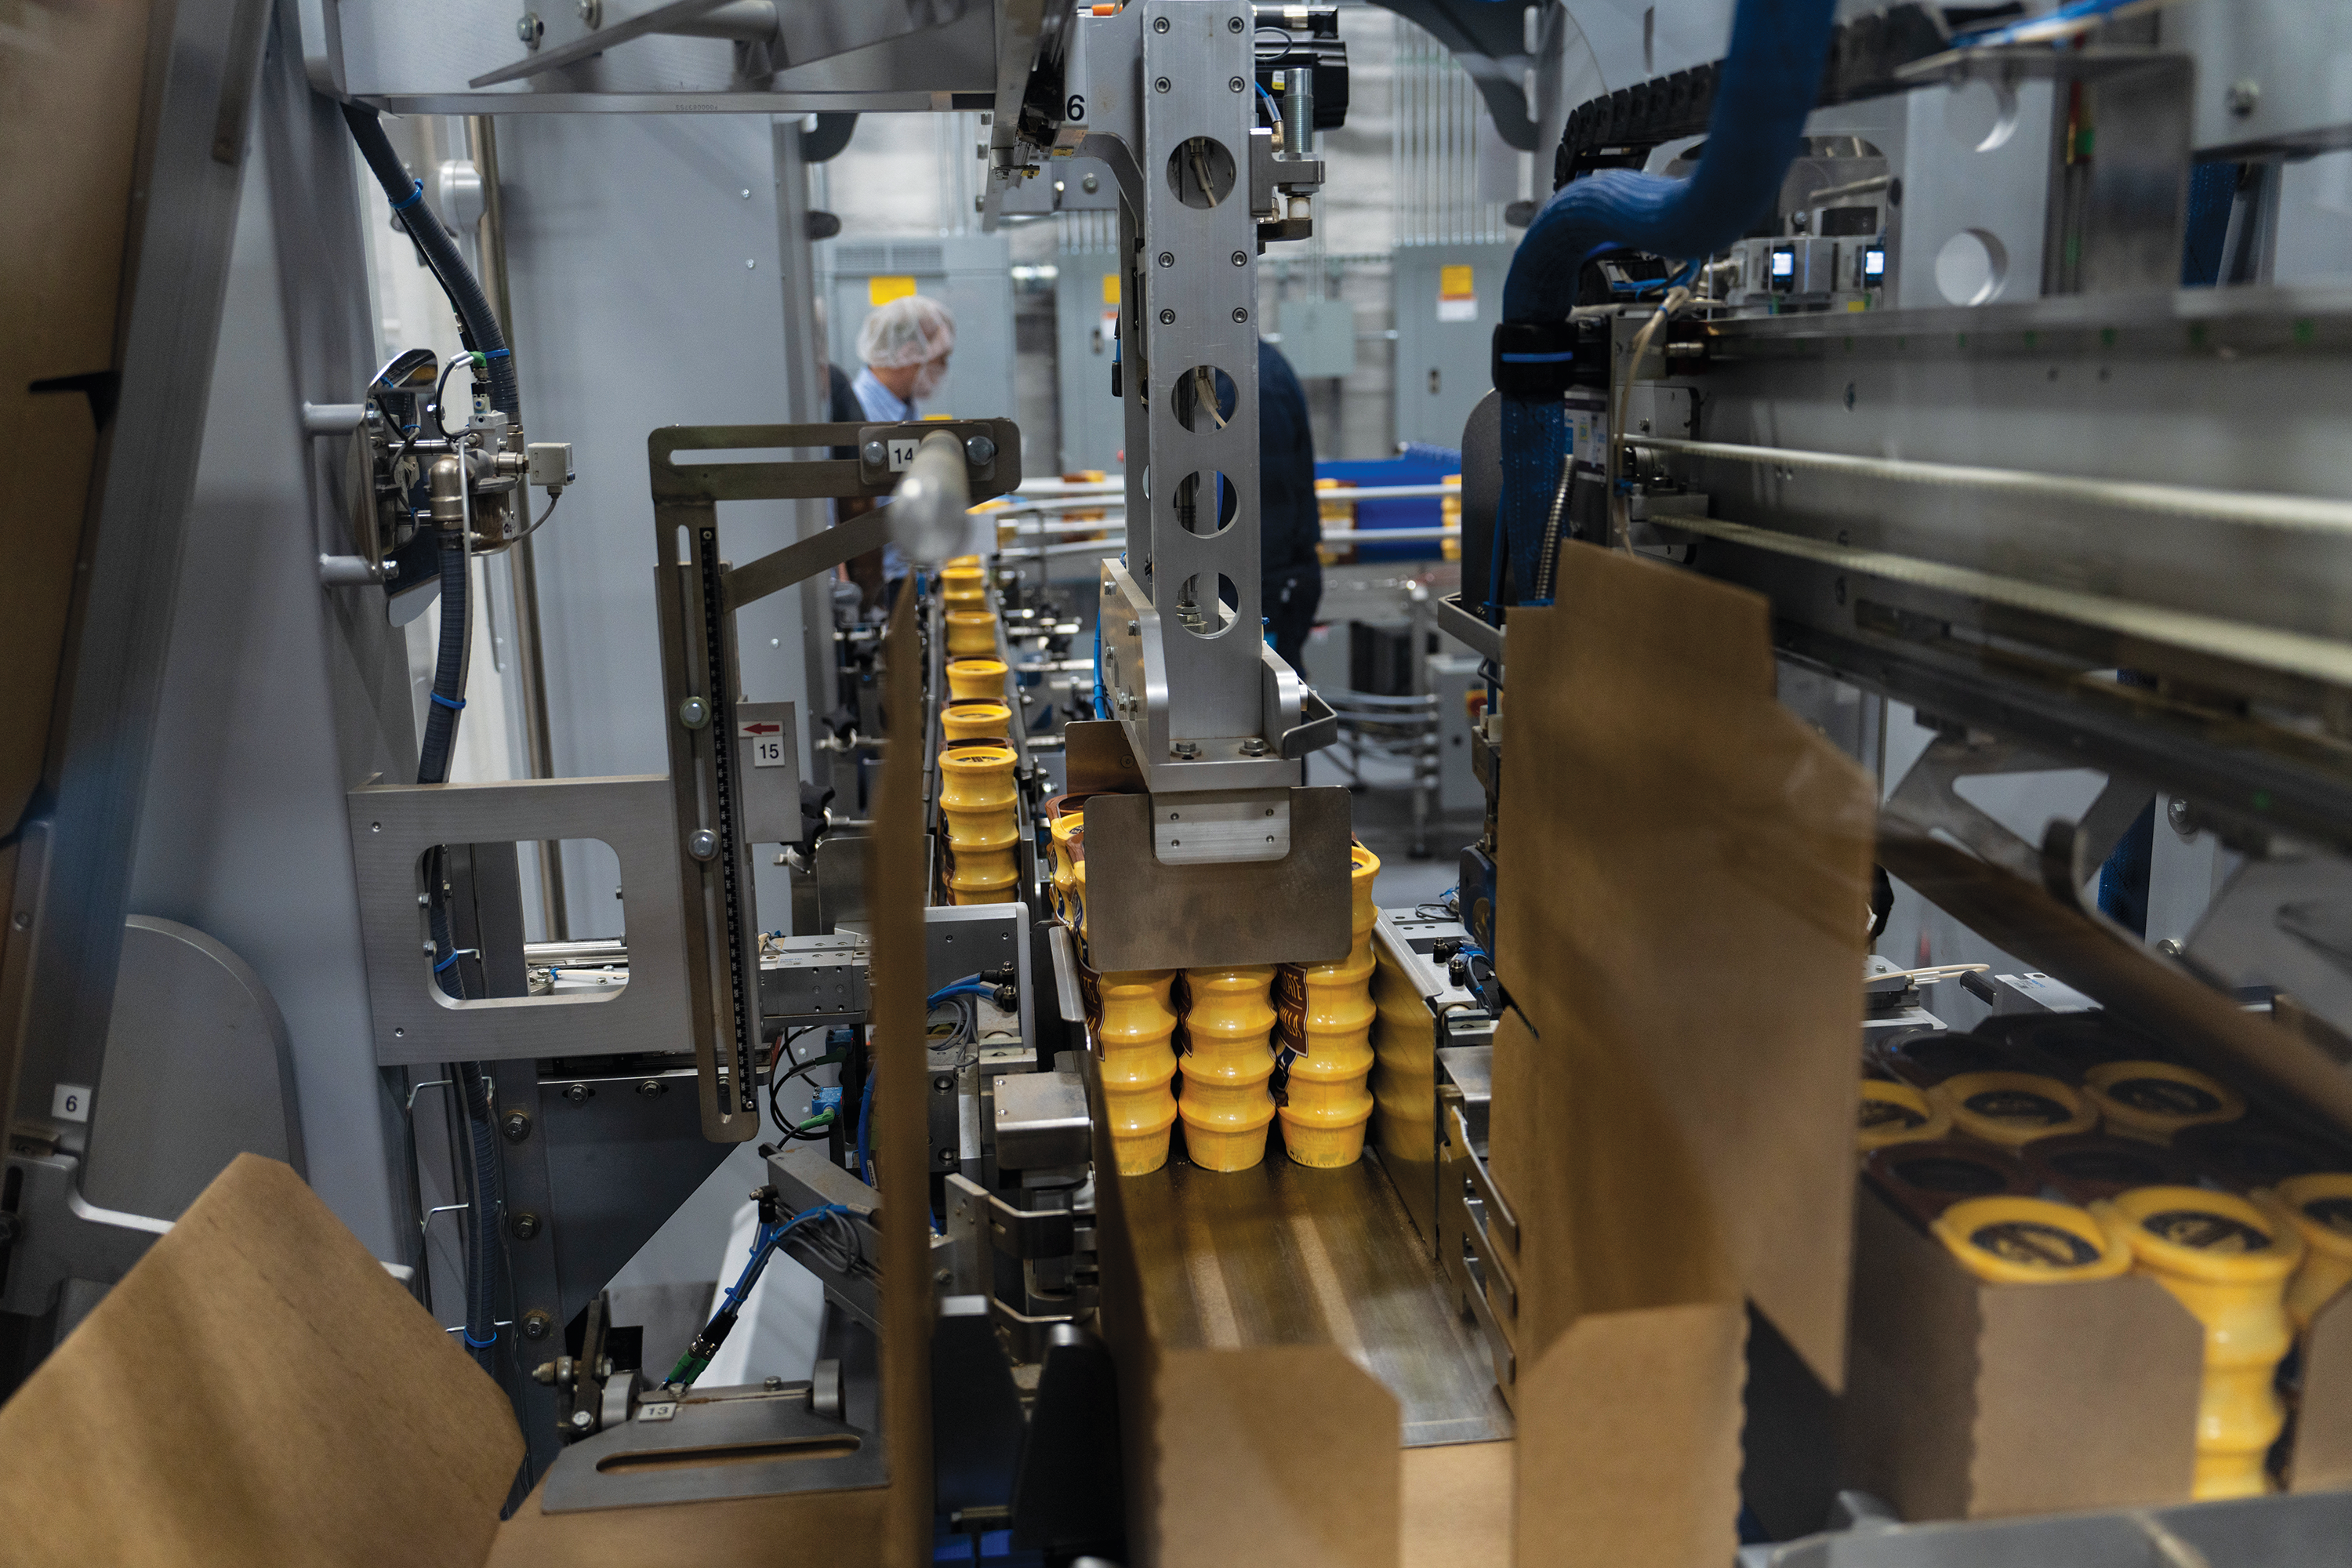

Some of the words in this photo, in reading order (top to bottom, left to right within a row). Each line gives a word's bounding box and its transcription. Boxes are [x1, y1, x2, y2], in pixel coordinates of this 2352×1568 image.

[1067, 94, 1085, 121] 6
[895, 448, 915, 464] 14
[760, 743, 779, 759] 15
[66, 1095, 78, 1112] 6
[649, 1406, 669, 1415] 13
